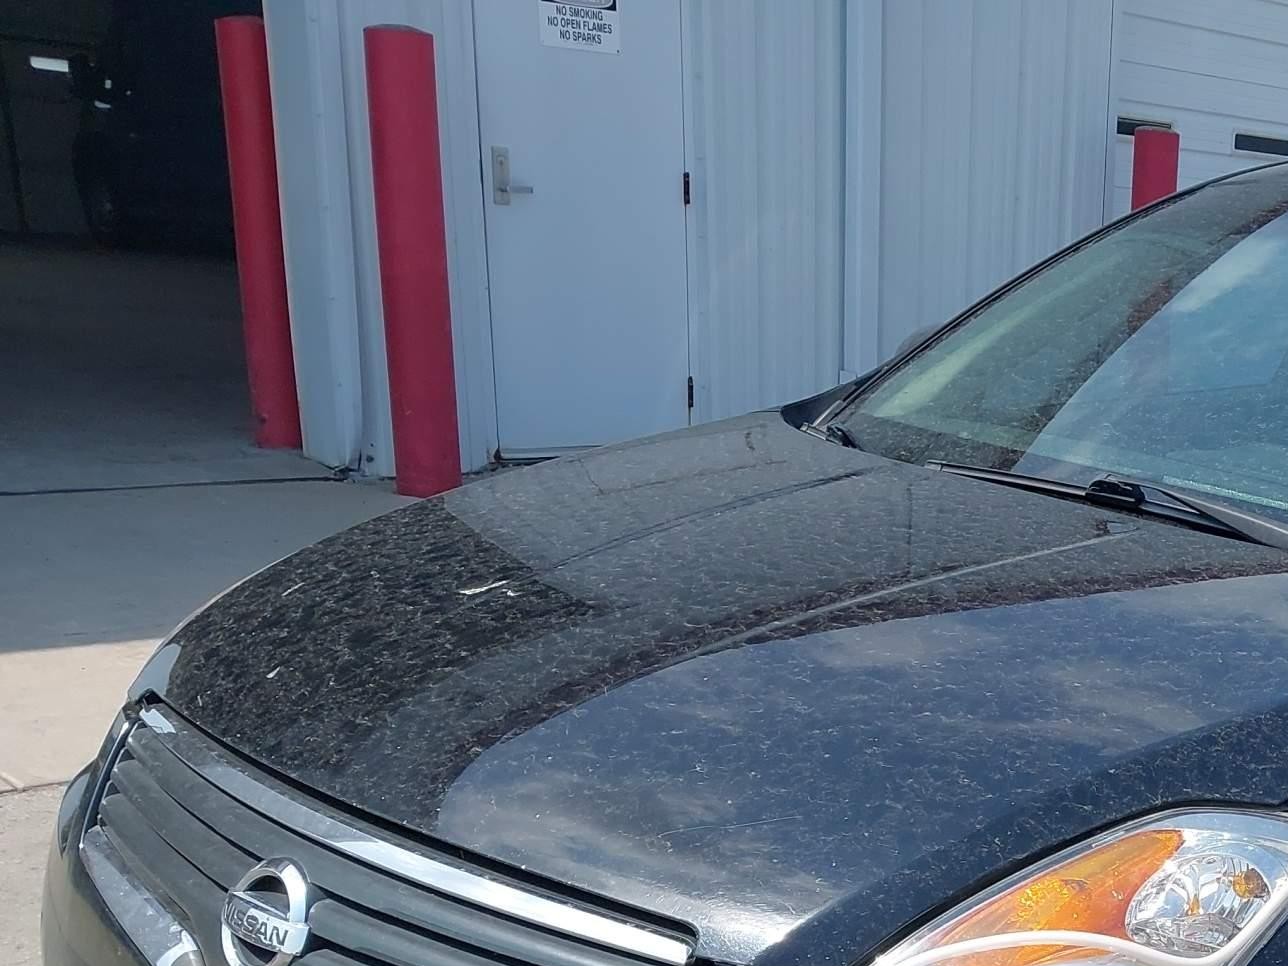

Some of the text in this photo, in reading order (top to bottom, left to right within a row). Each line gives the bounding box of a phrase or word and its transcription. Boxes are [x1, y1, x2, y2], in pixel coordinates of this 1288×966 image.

[556, 5, 603, 21] NO SMOKING
[547, 16, 613, 34] NO OPEN FLAMES
[560, 30, 602, 45] NO SPARKS
[223, 902, 289, 946] NISSAN
